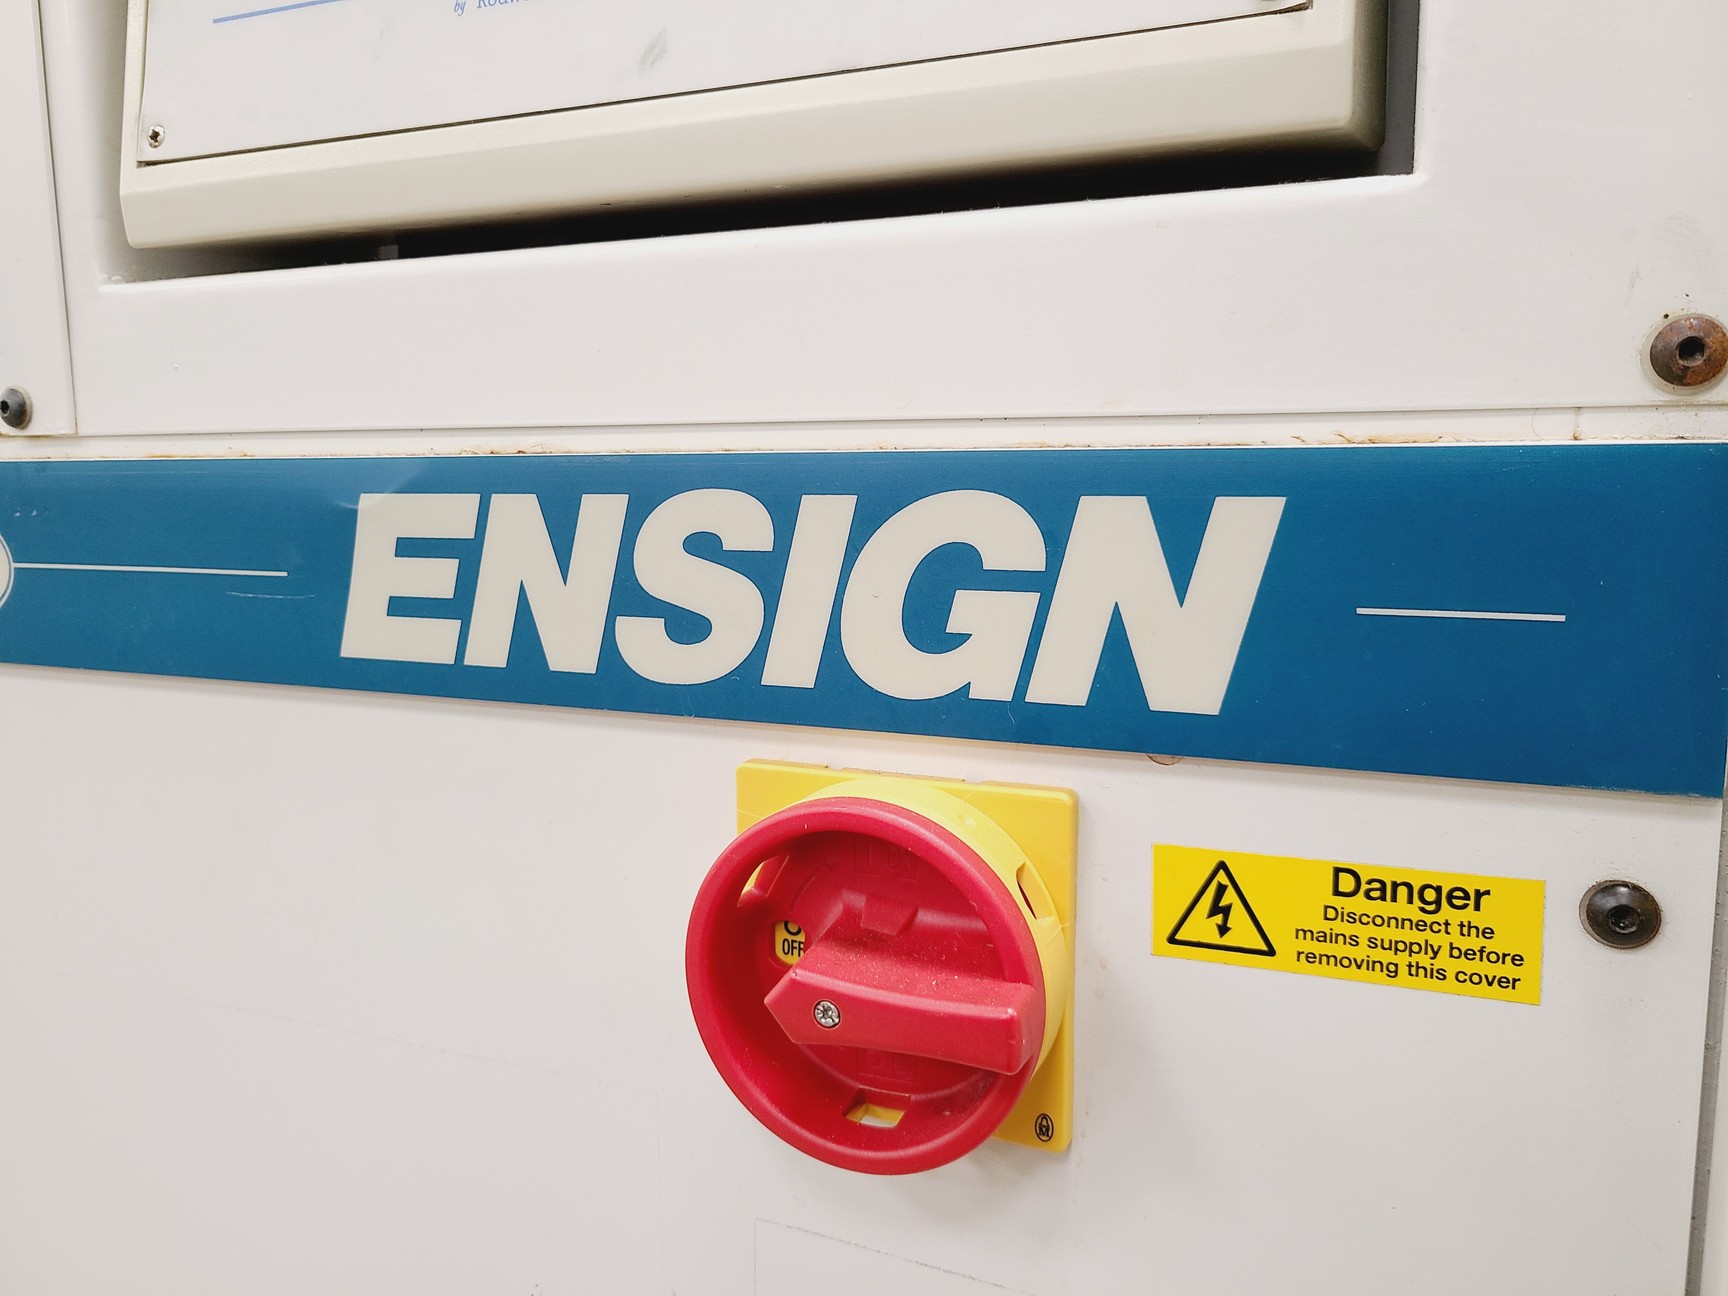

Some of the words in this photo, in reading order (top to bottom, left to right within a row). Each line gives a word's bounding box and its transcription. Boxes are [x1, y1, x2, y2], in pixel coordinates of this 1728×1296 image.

[340, 488, 1287, 717] ENSIGN
[1332, 866, 1491, 914] Danger
[1323, 905, 1452, 936] Disconnect
[1457, 920, 1495, 940] the
[782, 938, 806, 957] OFF
[1295, 926, 1361, 948] mains
[1366, 937, 1442, 961] supply
[1448, 944, 1525, 967] before
[1296, 949, 1400, 979] removing
[1406, 960, 1448, 982] this
[1454, 970, 1521, 991] cover
